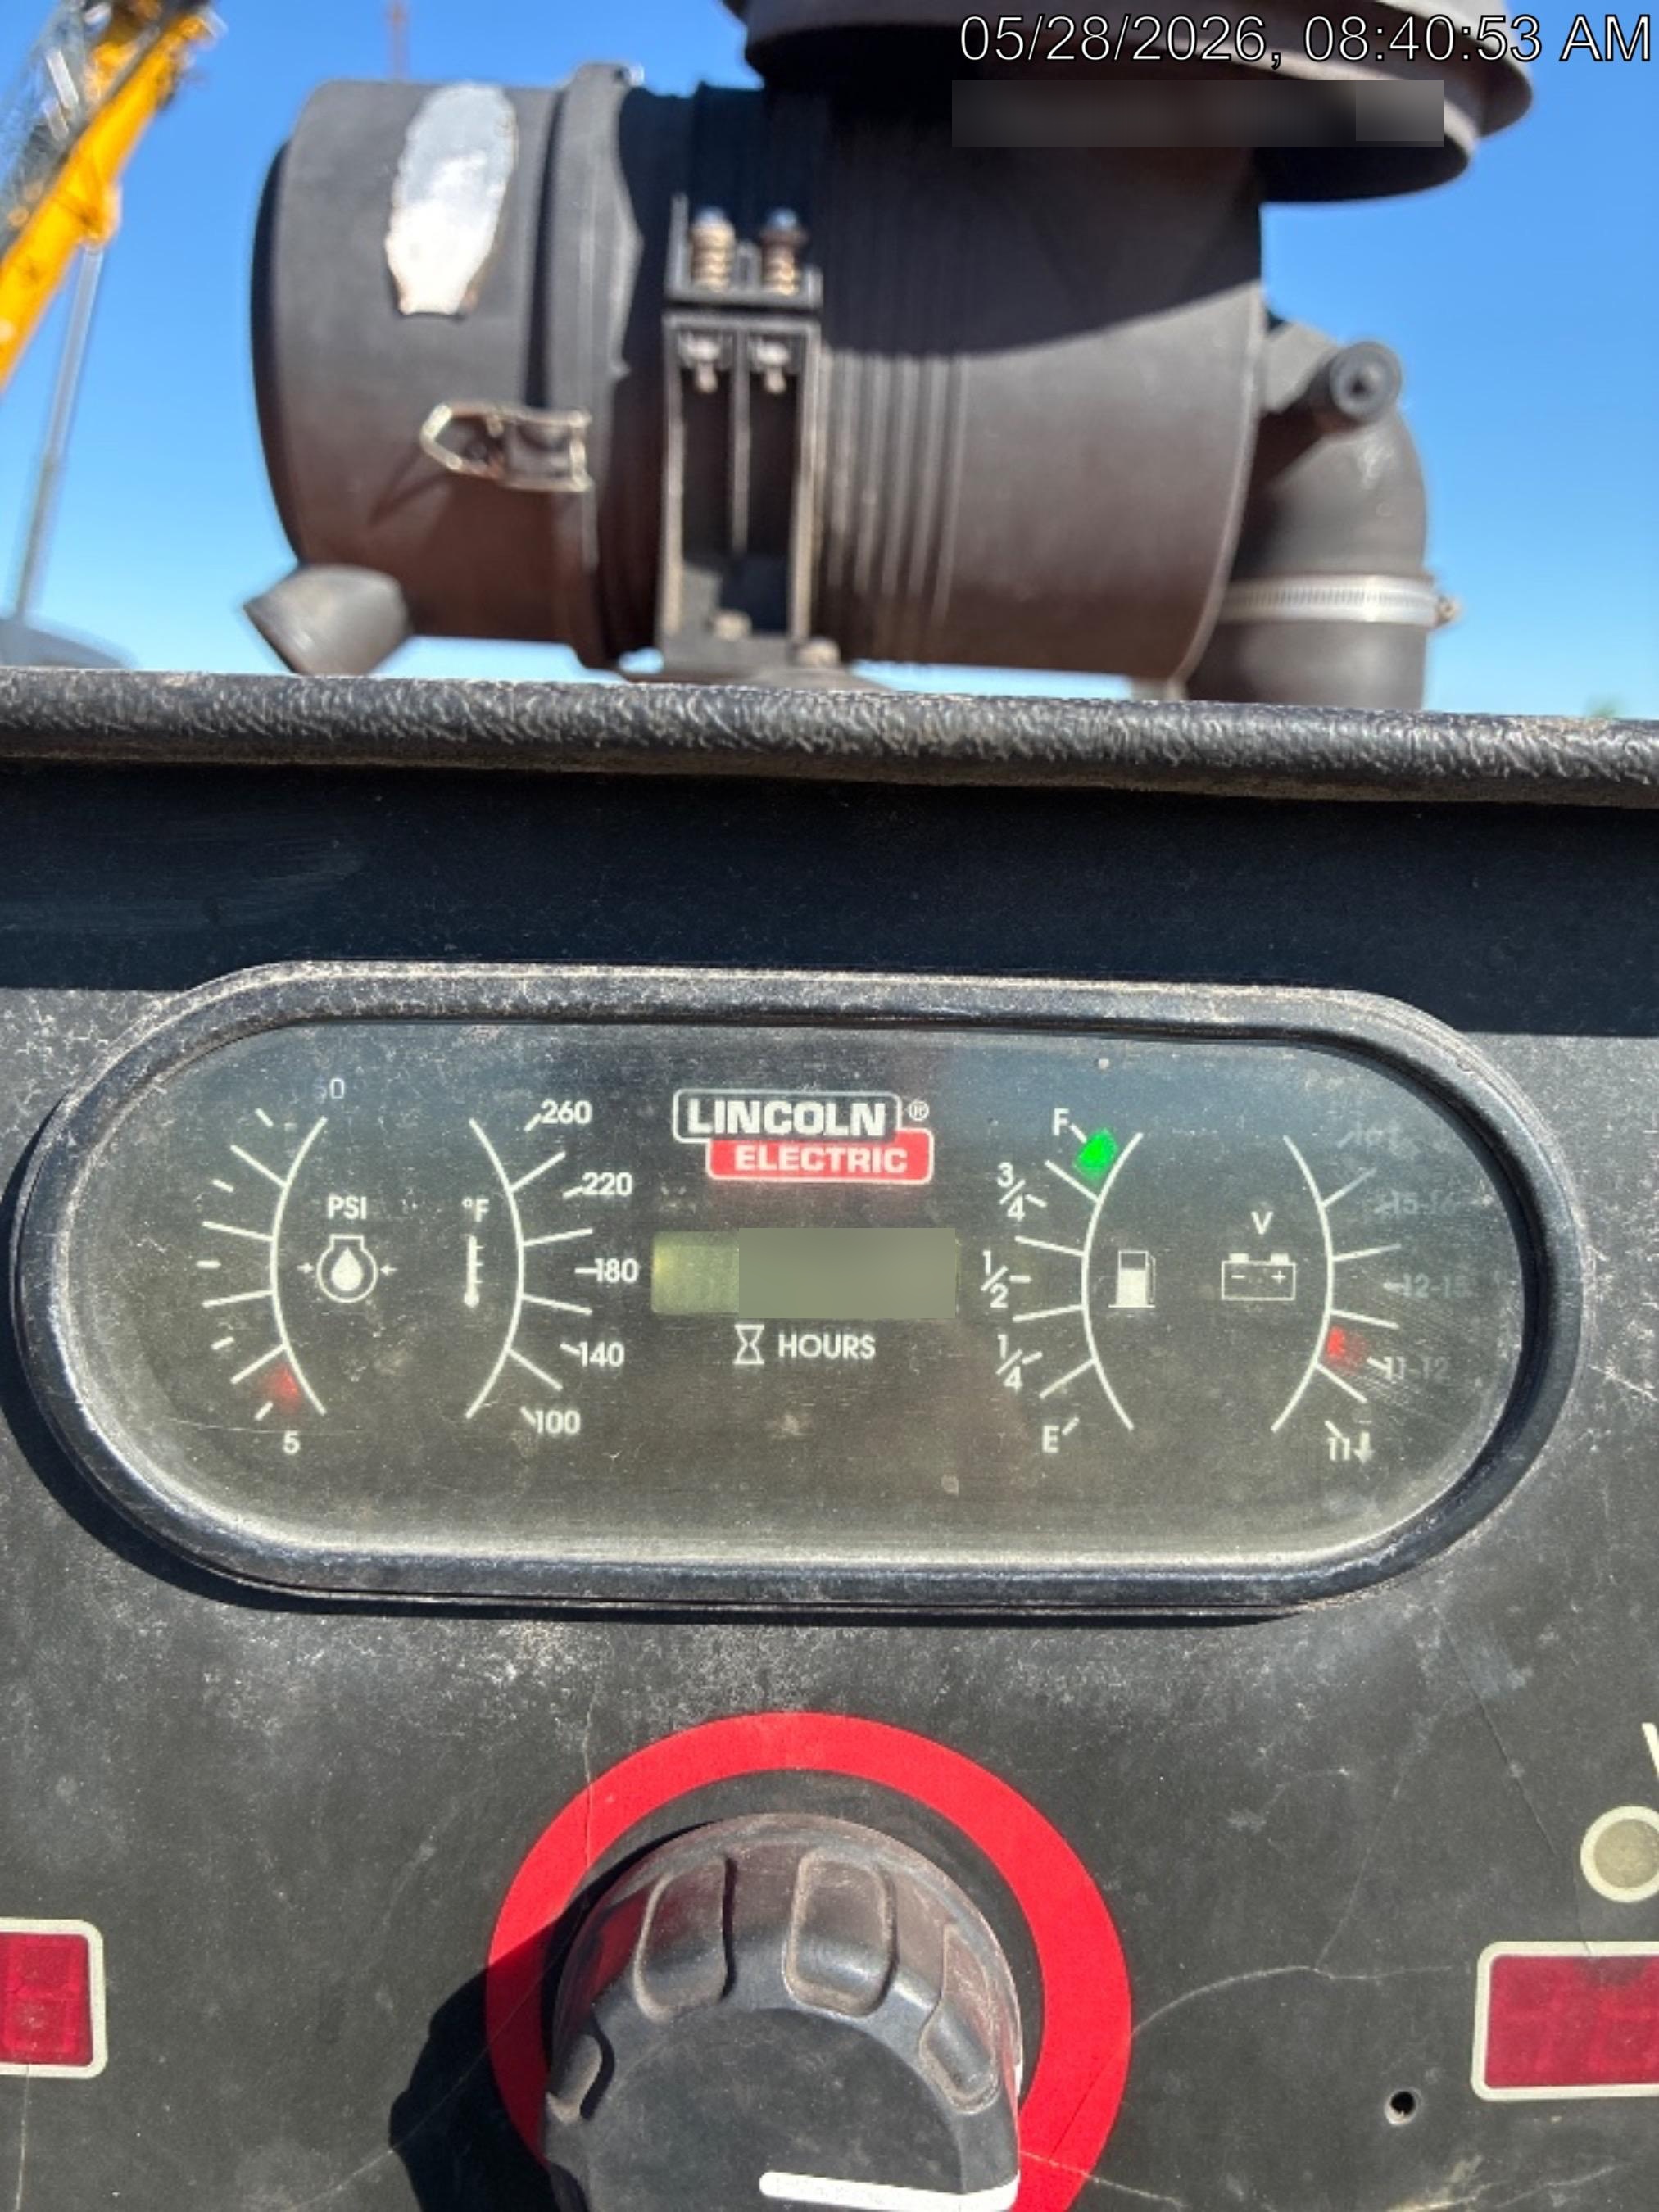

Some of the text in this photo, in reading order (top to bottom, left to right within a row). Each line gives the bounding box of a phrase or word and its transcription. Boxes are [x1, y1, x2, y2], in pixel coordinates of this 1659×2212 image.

[542, 1101, 592, 1125] 260
[687, 1100, 886, 1137] LINCOLN
[1052, 1108, 1070, 1136] F
[734, 1145, 909, 1174] ELECTRIC
[582, 1172, 632, 1197] 220
[329, 1197, 367, 1219] PSI
[1251, 1212, 1274, 1235] V
[595, 1258, 638, 1282] 180
[580, 1343, 624, 1367] 140
[778, 1333, 876, 1360] HOURS
[534, 1411, 580, 1435] 100
[284, 1430, 300, 1453] 5
[1042, 1426, 1060, 1453] E
